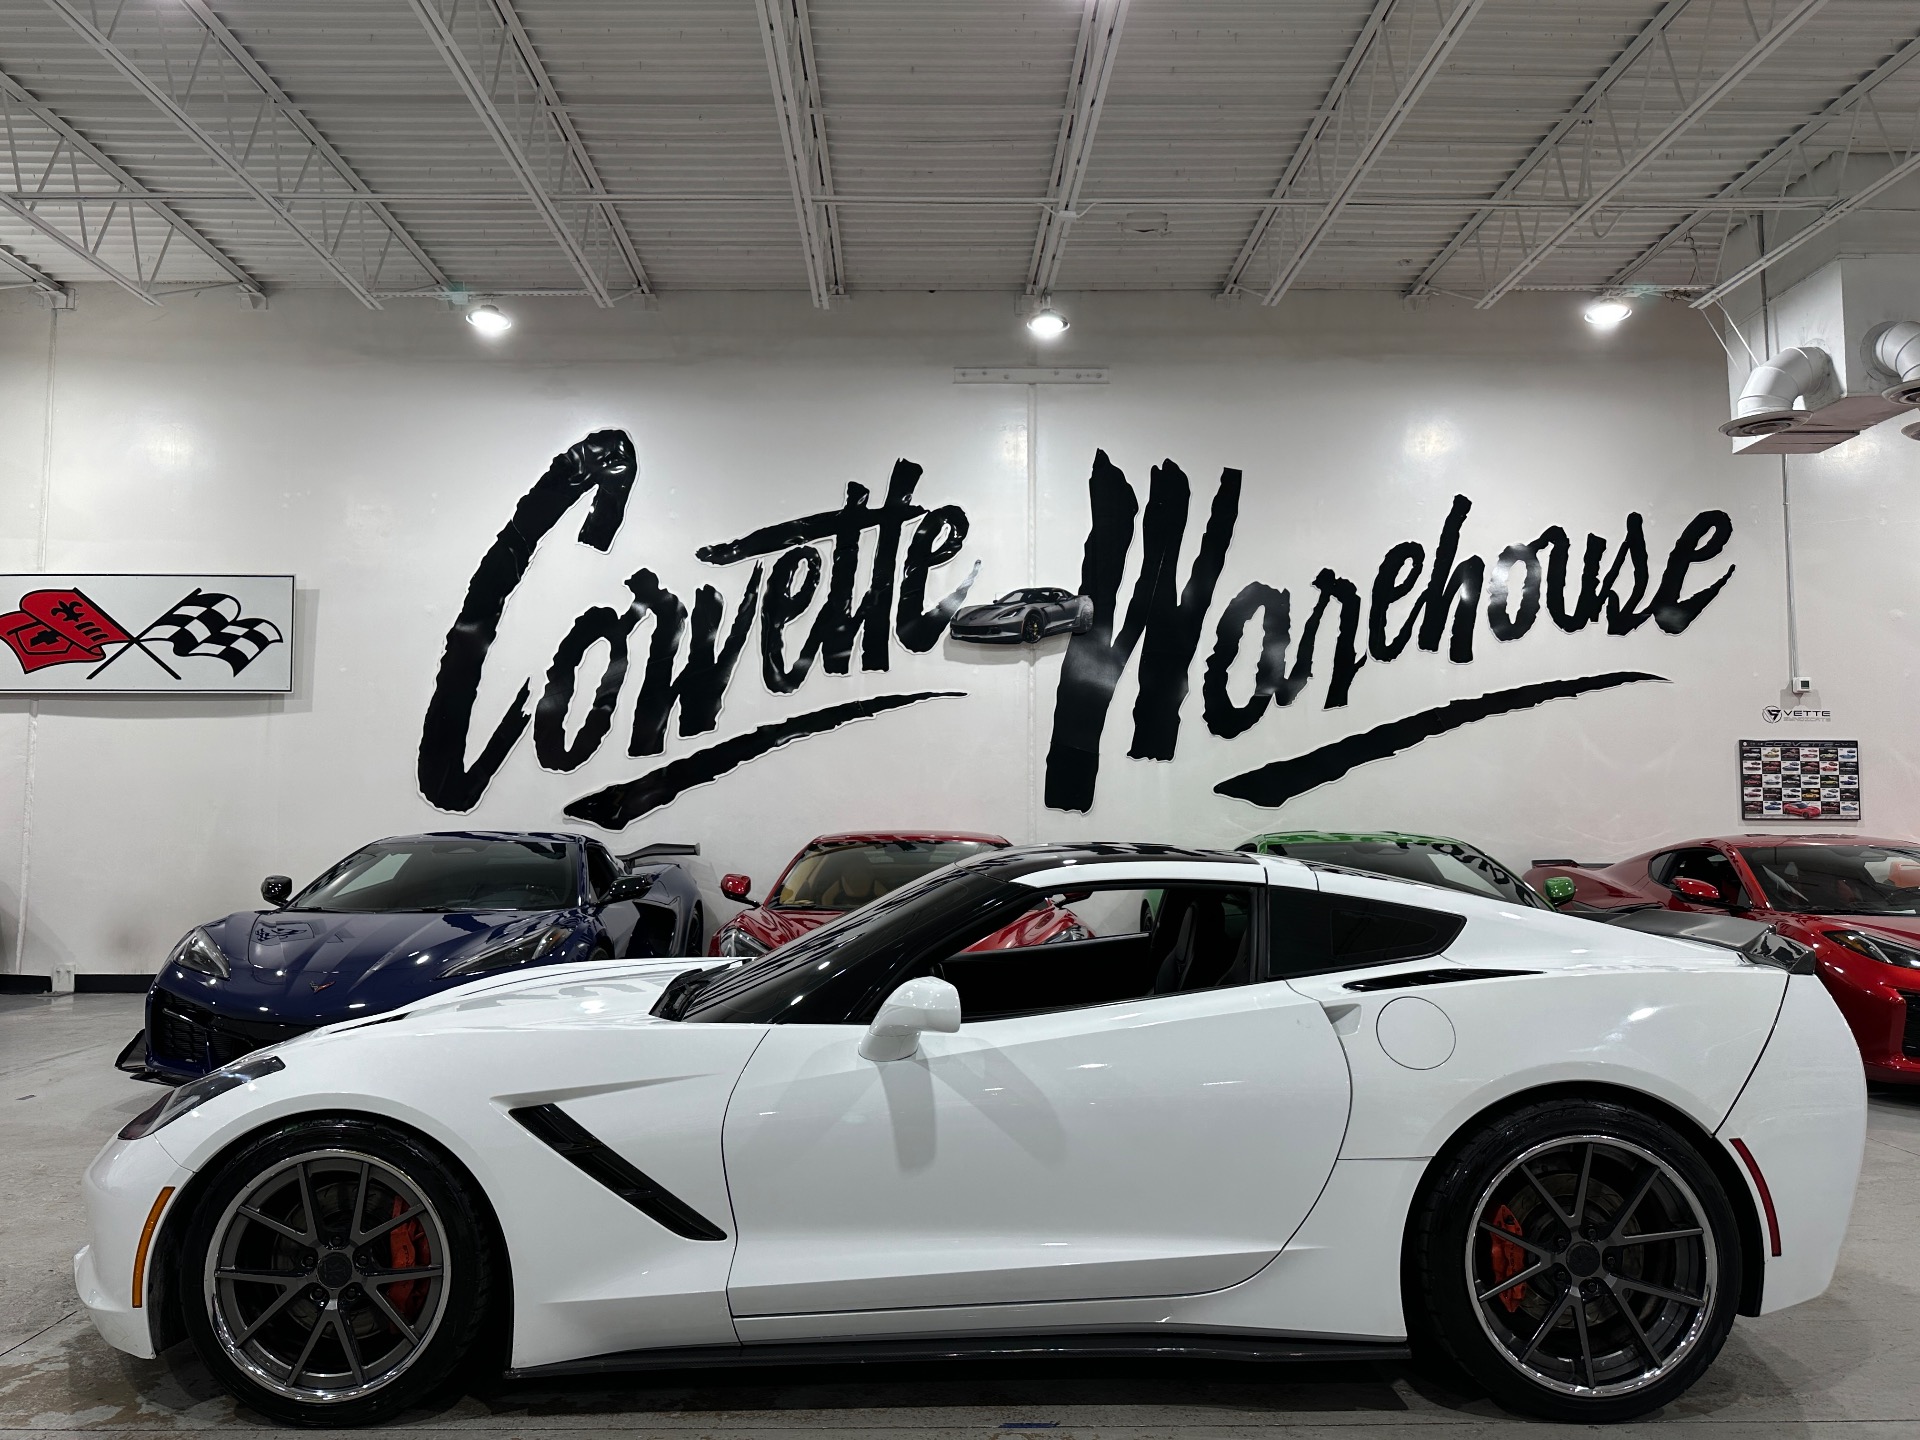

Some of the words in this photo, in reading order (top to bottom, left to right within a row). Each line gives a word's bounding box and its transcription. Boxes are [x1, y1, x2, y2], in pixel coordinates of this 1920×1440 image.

[417, 429, 982, 812] Corvette
[1044, 447, 1736, 813] Warehouse
[1783, 709, 1831, 717] VETTE
